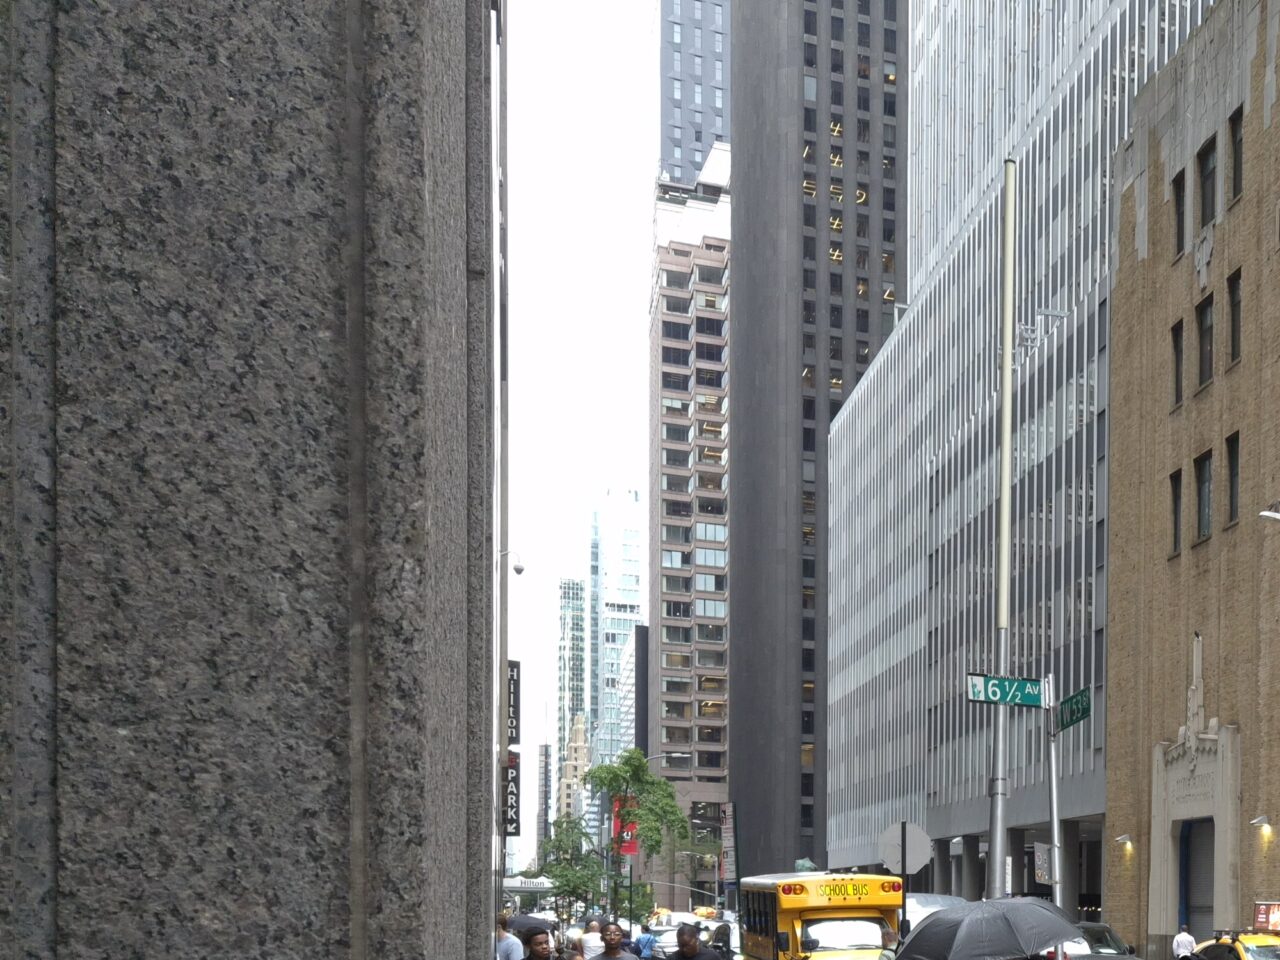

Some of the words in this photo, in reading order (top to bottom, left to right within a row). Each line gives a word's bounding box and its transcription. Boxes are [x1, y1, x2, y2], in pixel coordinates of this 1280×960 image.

[1025, 682, 1039, 695] Av
[507, 667, 518, 738] Hilton
[1062, 700, 1071, 726] W
[1072, 695, 1083, 720] 53
[507, 769, 518, 820] PARK
[520, 879, 545, 887] Hilton
[819, 884, 850, 897] SCHOOL
[852, 883, 869, 896] BUS
